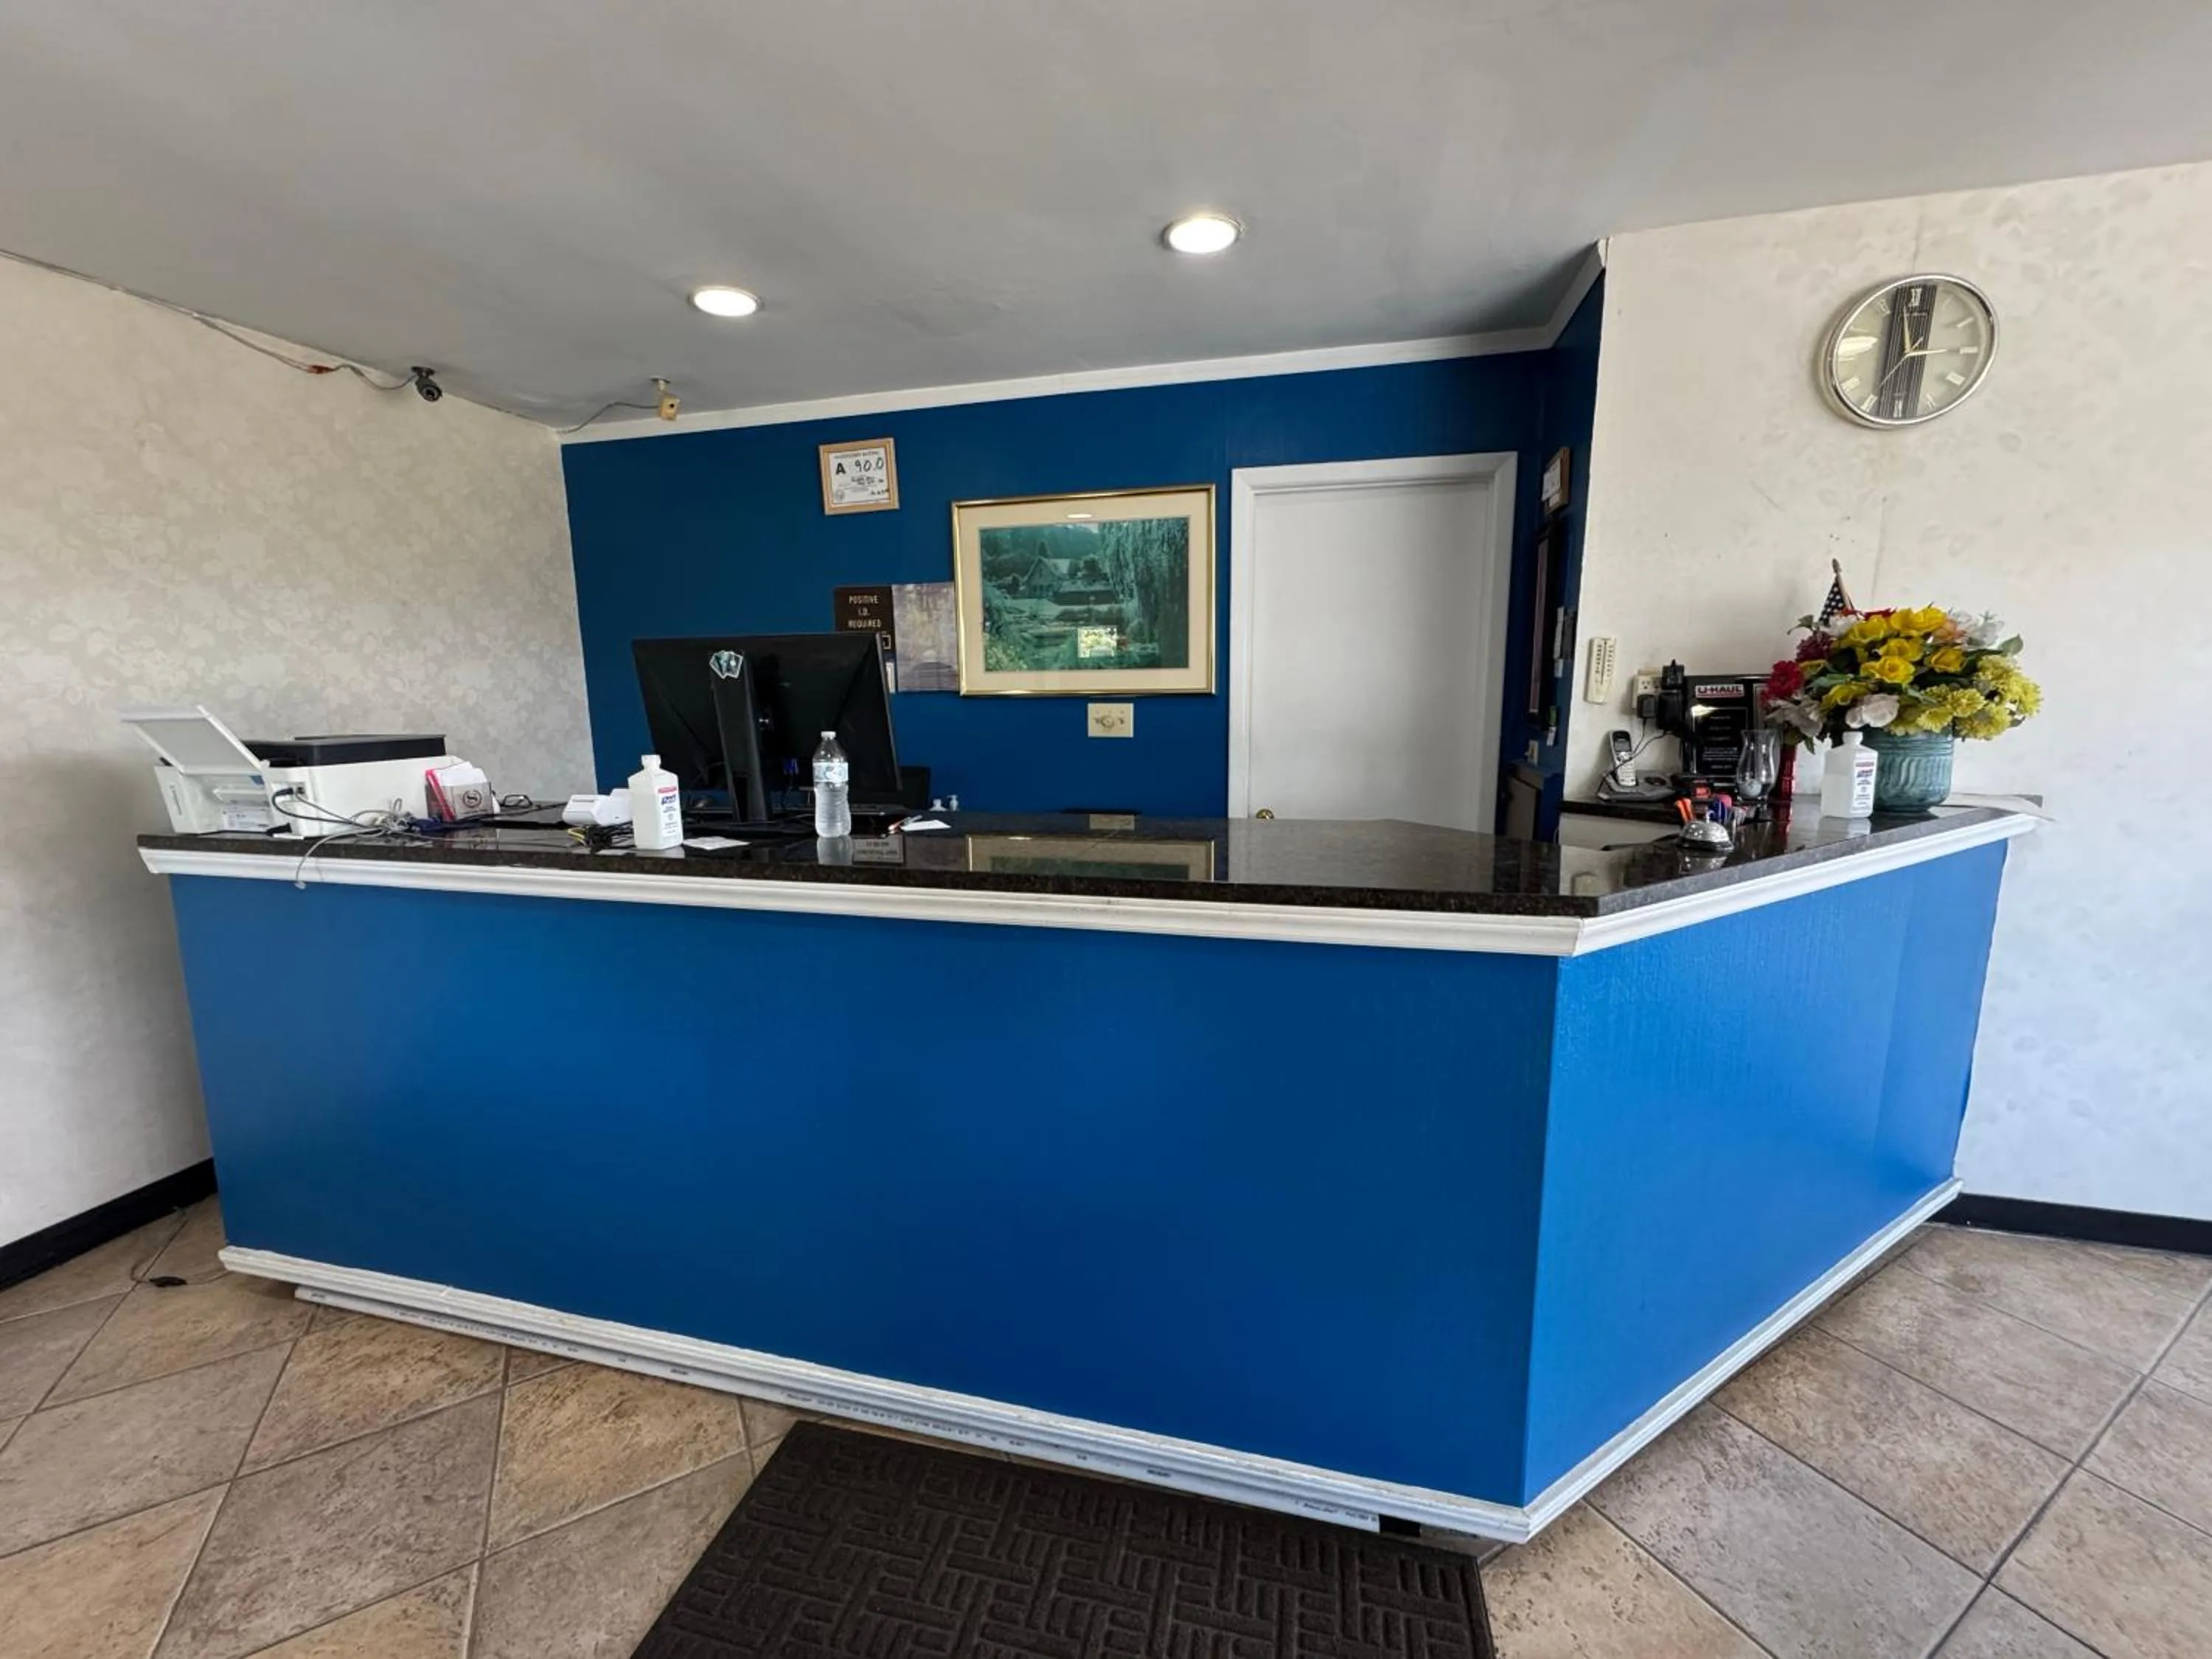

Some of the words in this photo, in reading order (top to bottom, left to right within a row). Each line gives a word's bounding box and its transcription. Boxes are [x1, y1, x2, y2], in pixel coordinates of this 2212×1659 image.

[835, 462, 846, 475] A
[849, 595, 879, 604] POSITIVE
[847, 619, 882, 629] REQUIRED
[1697, 685, 1742, 694] U-HAUL
